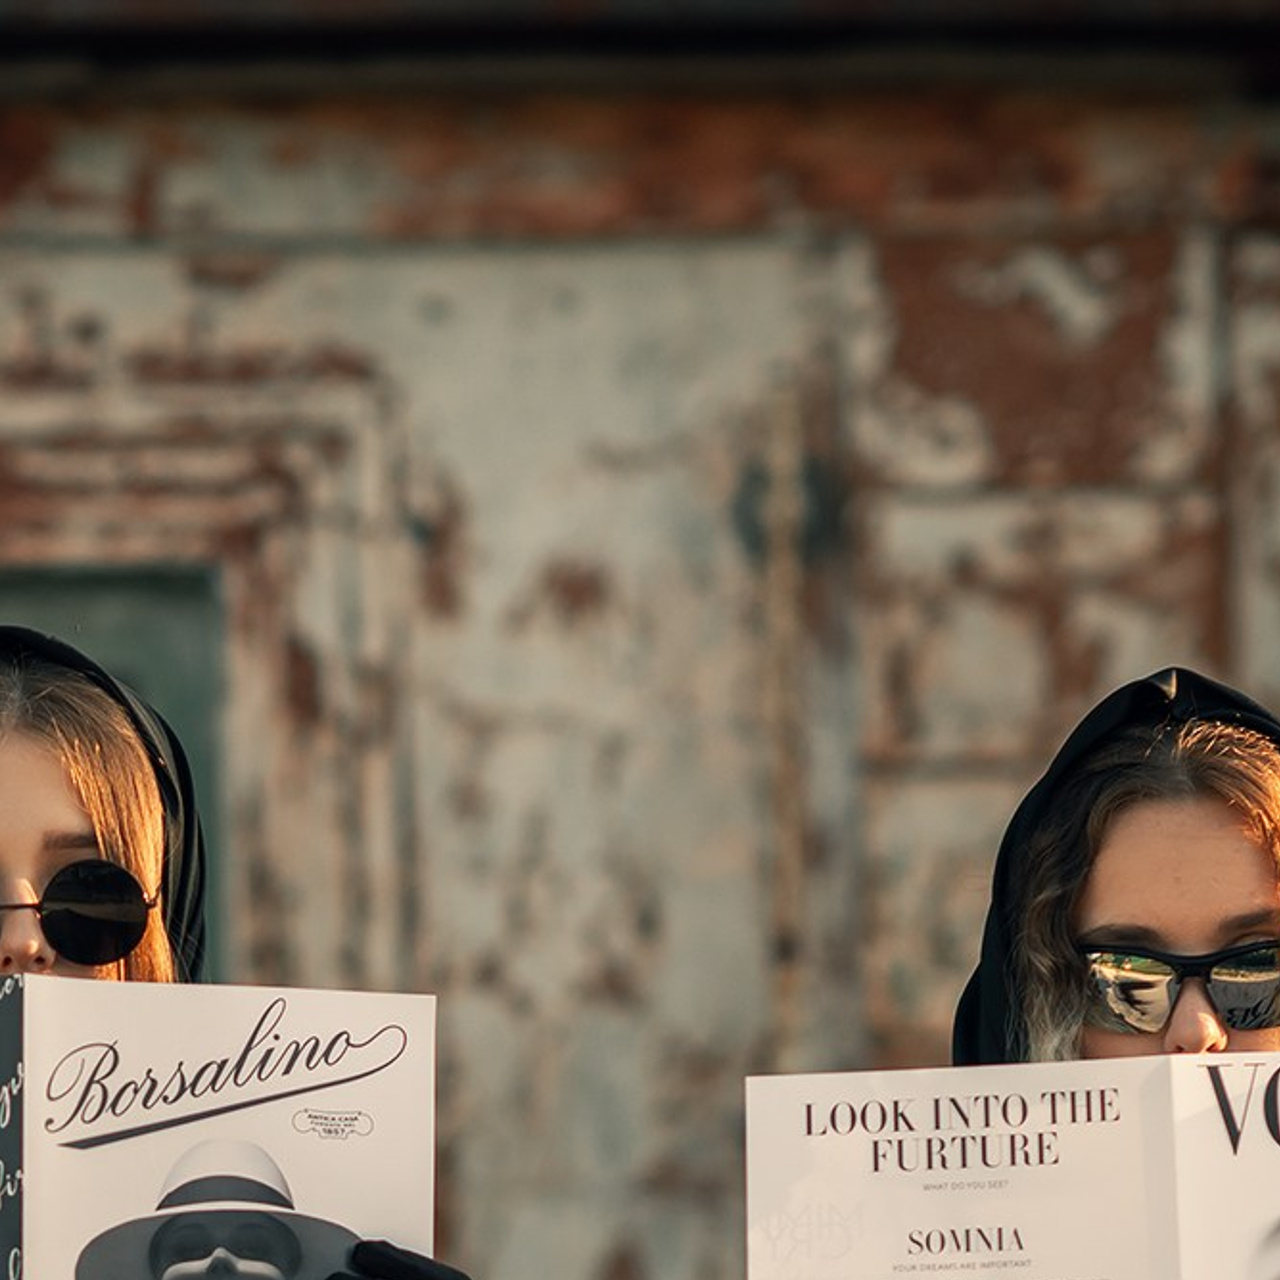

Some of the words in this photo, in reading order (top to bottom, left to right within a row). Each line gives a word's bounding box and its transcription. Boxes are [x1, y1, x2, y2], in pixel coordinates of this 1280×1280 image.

[43, 997, 408, 1138] Borsalino
[803, 1100, 916, 1137] LOOK
[933, 1094, 1029, 1132] INTO
[1042, 1087, 1120, 1125] THE
[872, 1132, 1060, 1174] FURTURE
[923, 1182, 949, 1191] WHAT
[951, 1181, 965, 1191] DO
[966, 1181, 986, 1190] YOU
[987, 1180, 1009, 1189] SEE?
[907, 1227, 1024, 1255] SOMNIA
[893, 1264, 917, 1273] YOUR
[920, 1262, 958, 1272] DREAMS
[960, 1261, 977, 1270] ARE
[980, 1259, 1032, 1270] IMPORTANT
